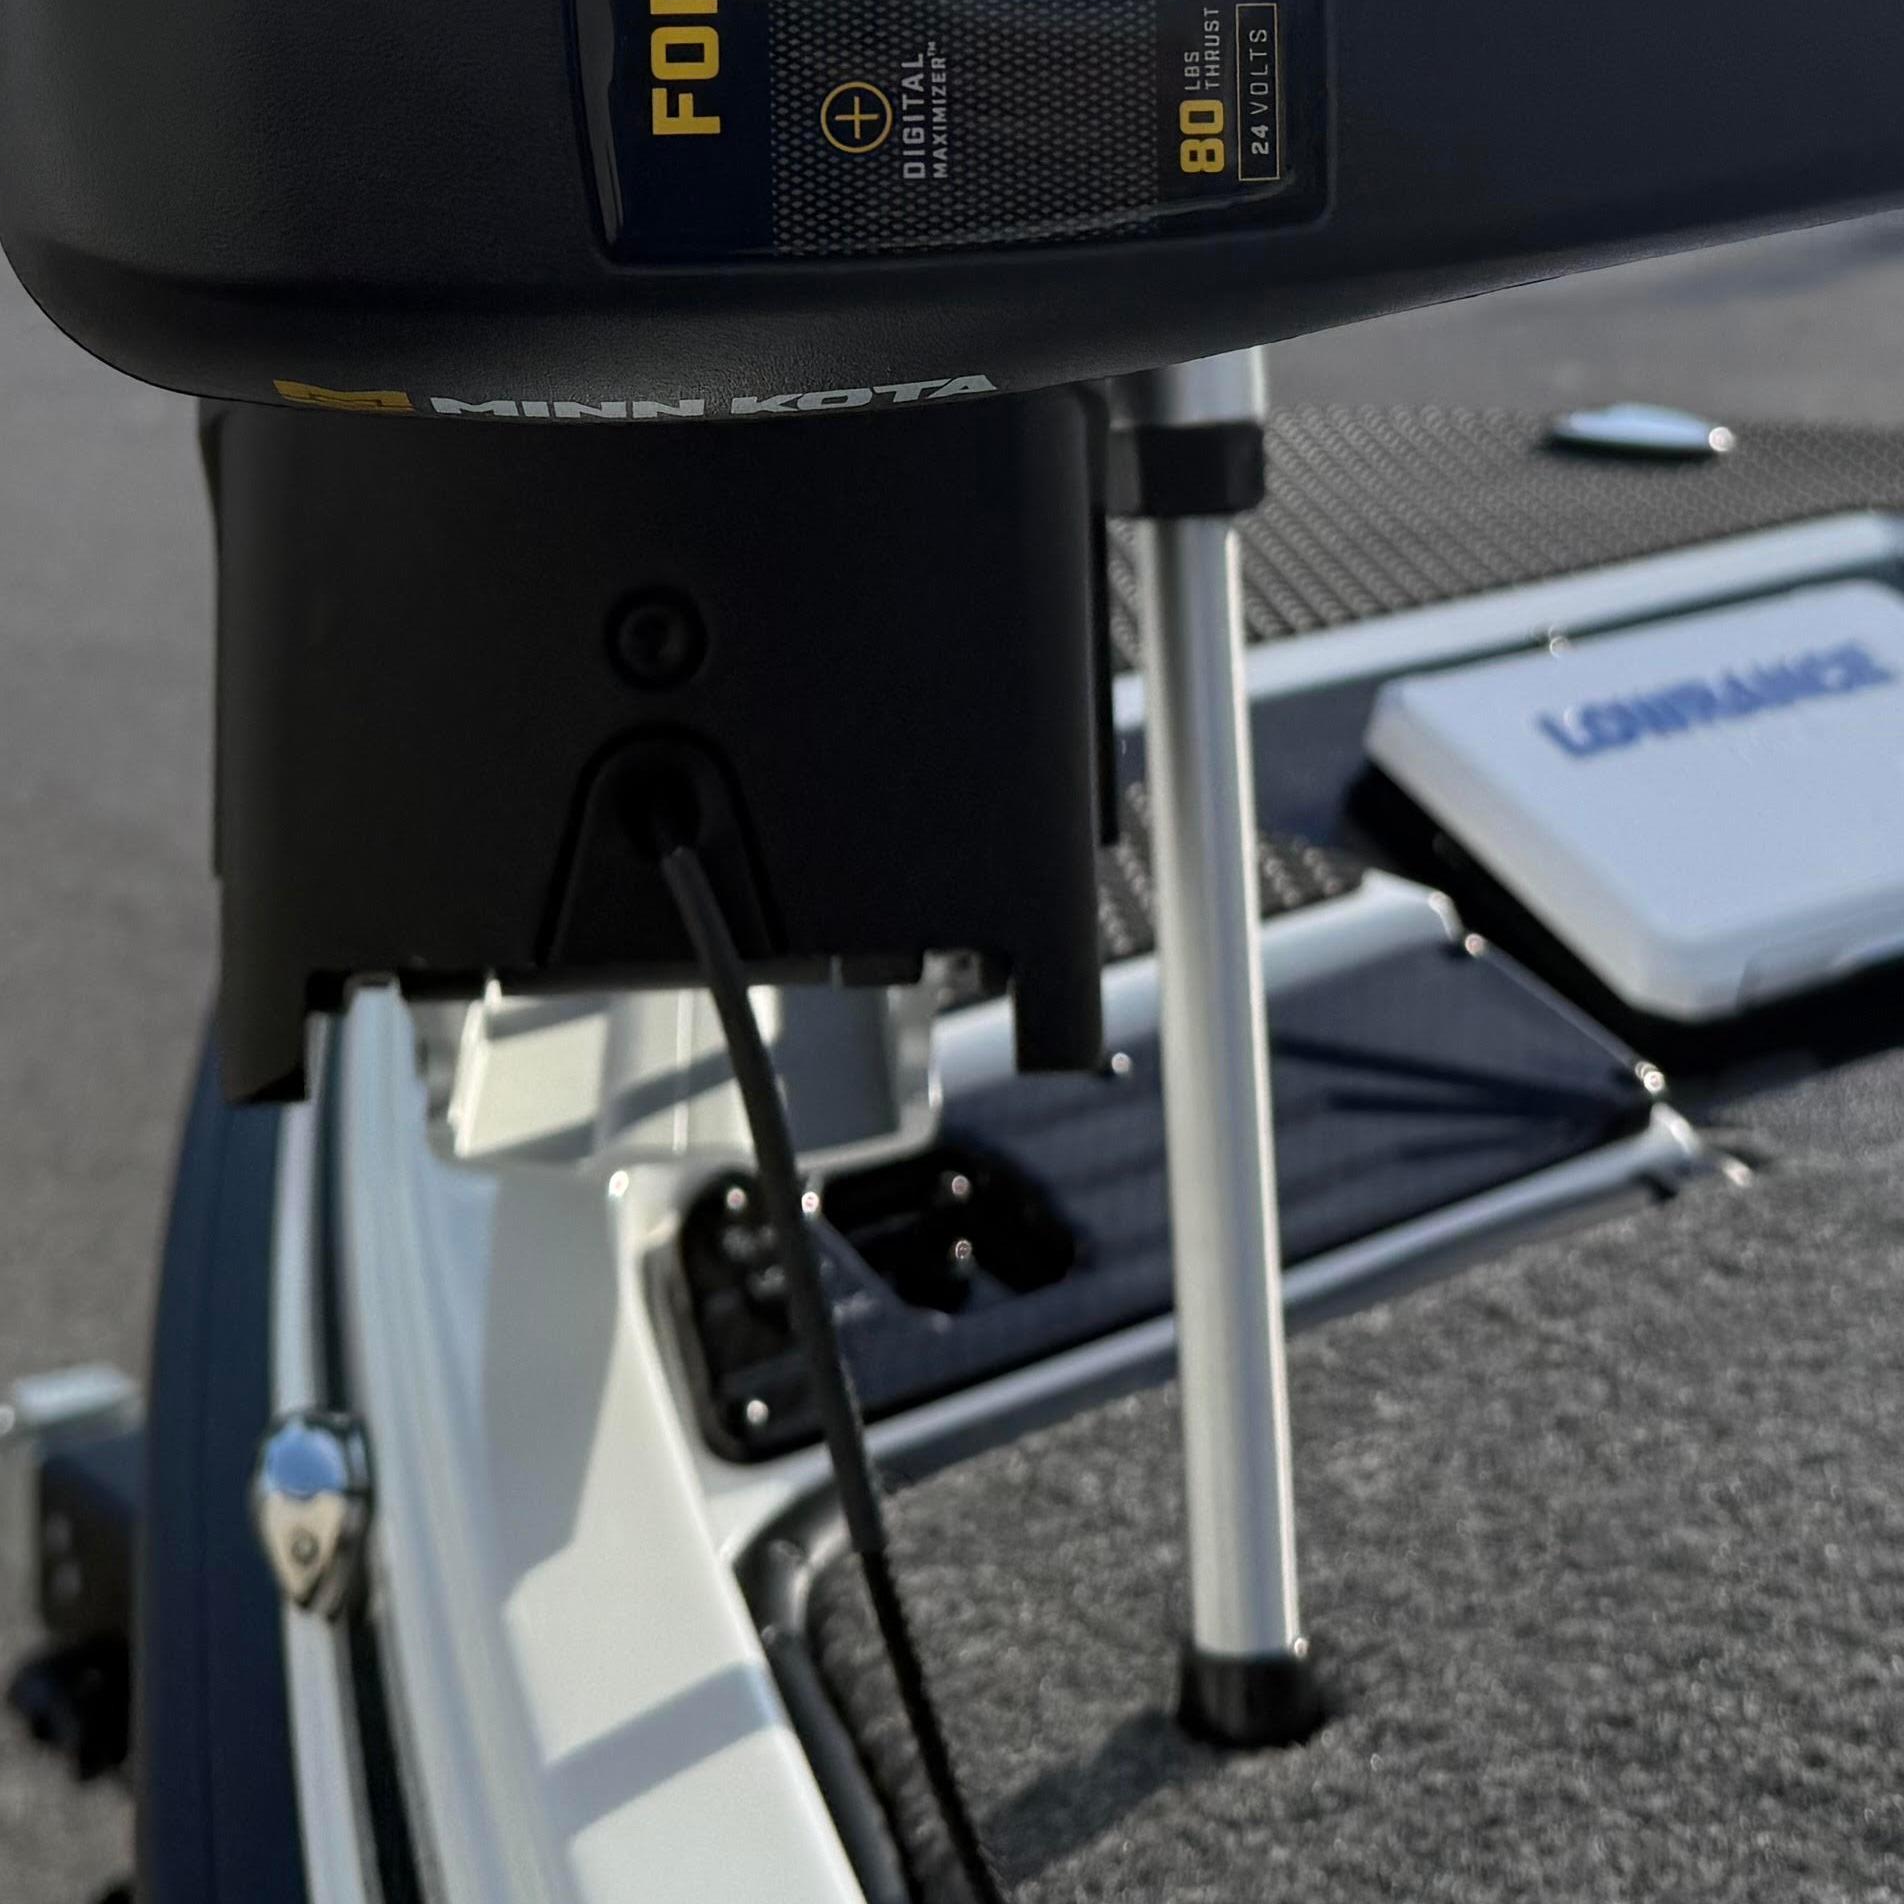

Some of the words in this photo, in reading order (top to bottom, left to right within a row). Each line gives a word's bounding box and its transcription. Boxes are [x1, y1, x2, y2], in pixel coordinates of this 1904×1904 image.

[1184, 51, 1200, 90] LBS
[1203, 7, 1220, 90] THRUST
[1249, 29, 1269, 115] VOLTS
[901, 53, 926, 179] DIGITAL
[1179, 99, 1225, 173] 80
[1251, 124, 1269, 155] 24
[429, 396, 705, 418] MINN
[731, 374, 998, 415] KOTA
[1534, 639, 1900, 760] LOWRANCE
